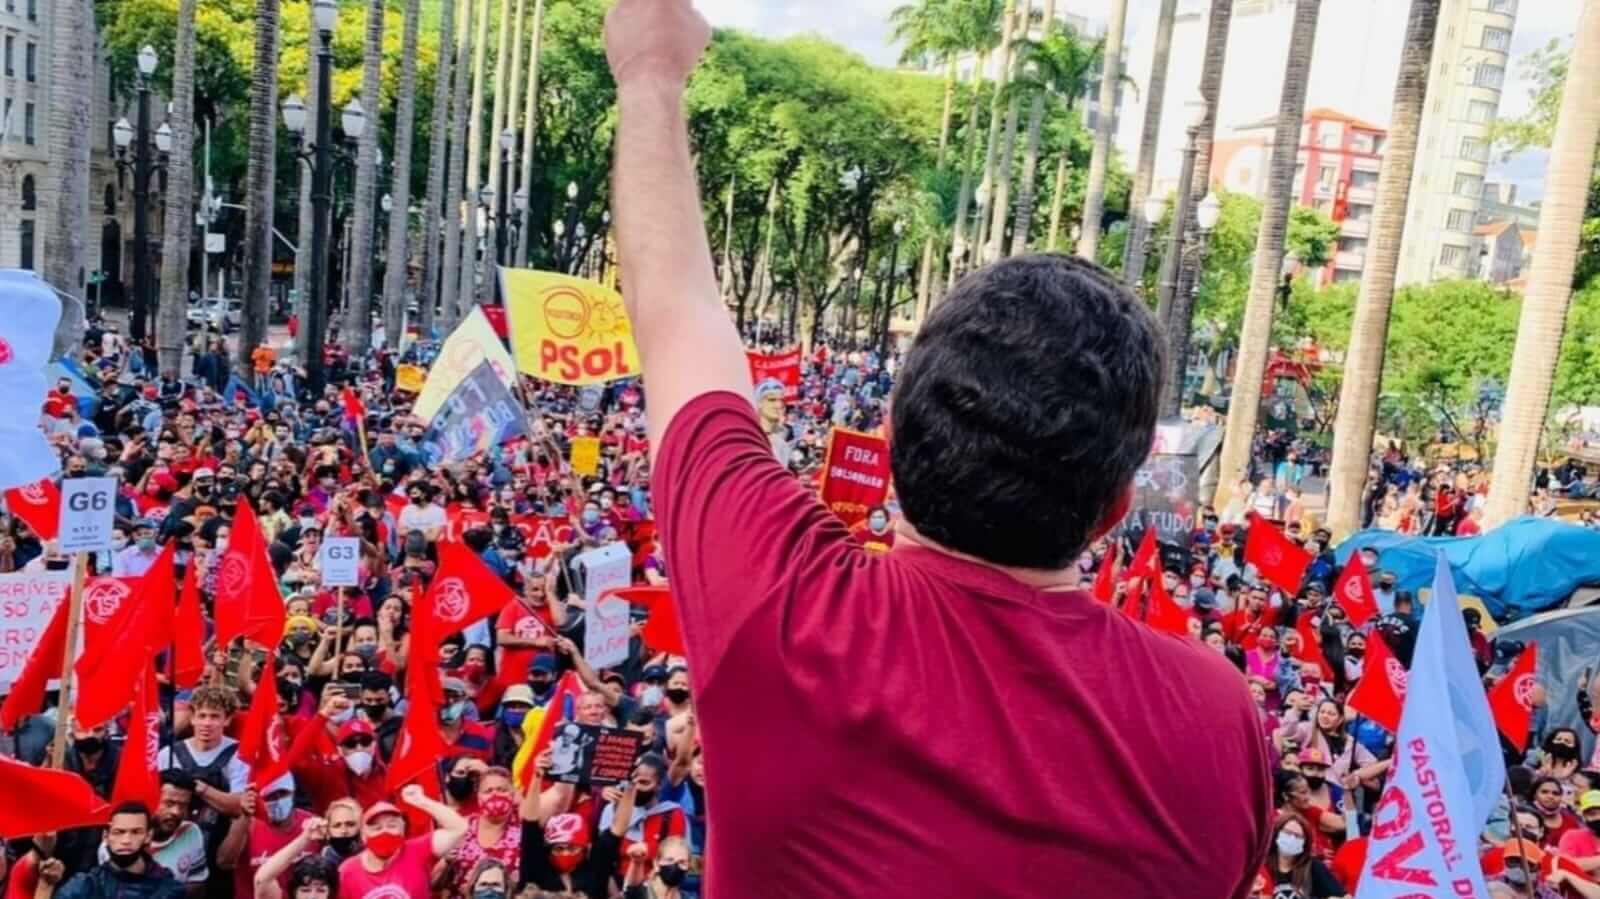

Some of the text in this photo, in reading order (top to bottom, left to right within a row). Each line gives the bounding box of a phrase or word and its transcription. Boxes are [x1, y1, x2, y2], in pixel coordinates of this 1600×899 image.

[541, 338, 630, 380] PSOL
[844, 445, 880, 467] FORA
[69, 490, 107, 512] G6
[1148, 511, 1194, 537] TUDO
[328, 546, 354, 560] G3
[1408, 737, 1477, 899] PASTORAL D
